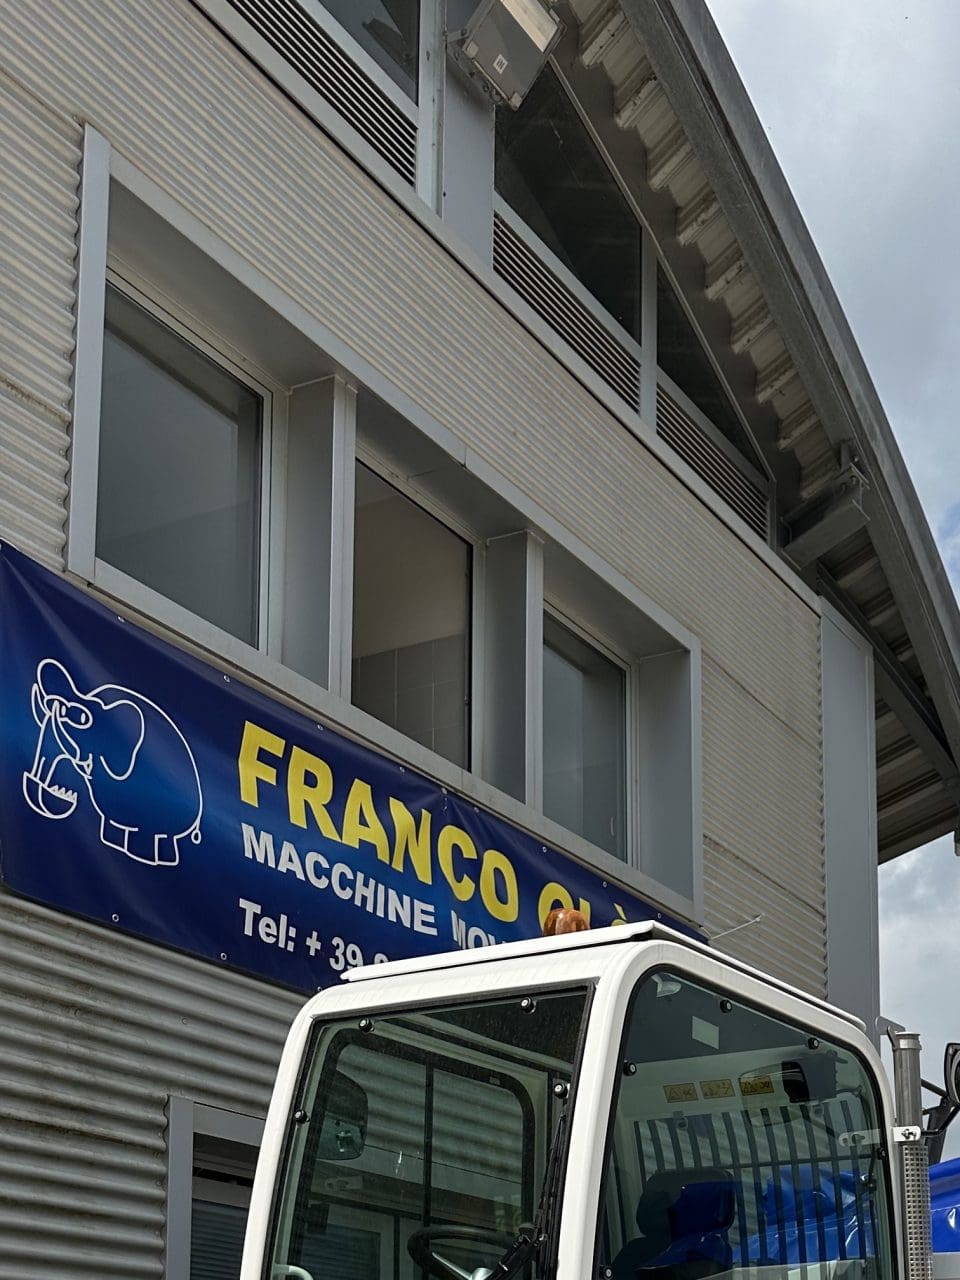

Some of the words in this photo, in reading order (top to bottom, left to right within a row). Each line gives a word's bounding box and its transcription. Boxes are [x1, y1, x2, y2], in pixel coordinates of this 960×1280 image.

[239, 720, 519, 922] FRANCO
[239, 898, 297, 952] Tel:
[242, 823, 438, 936] MACCHINE
